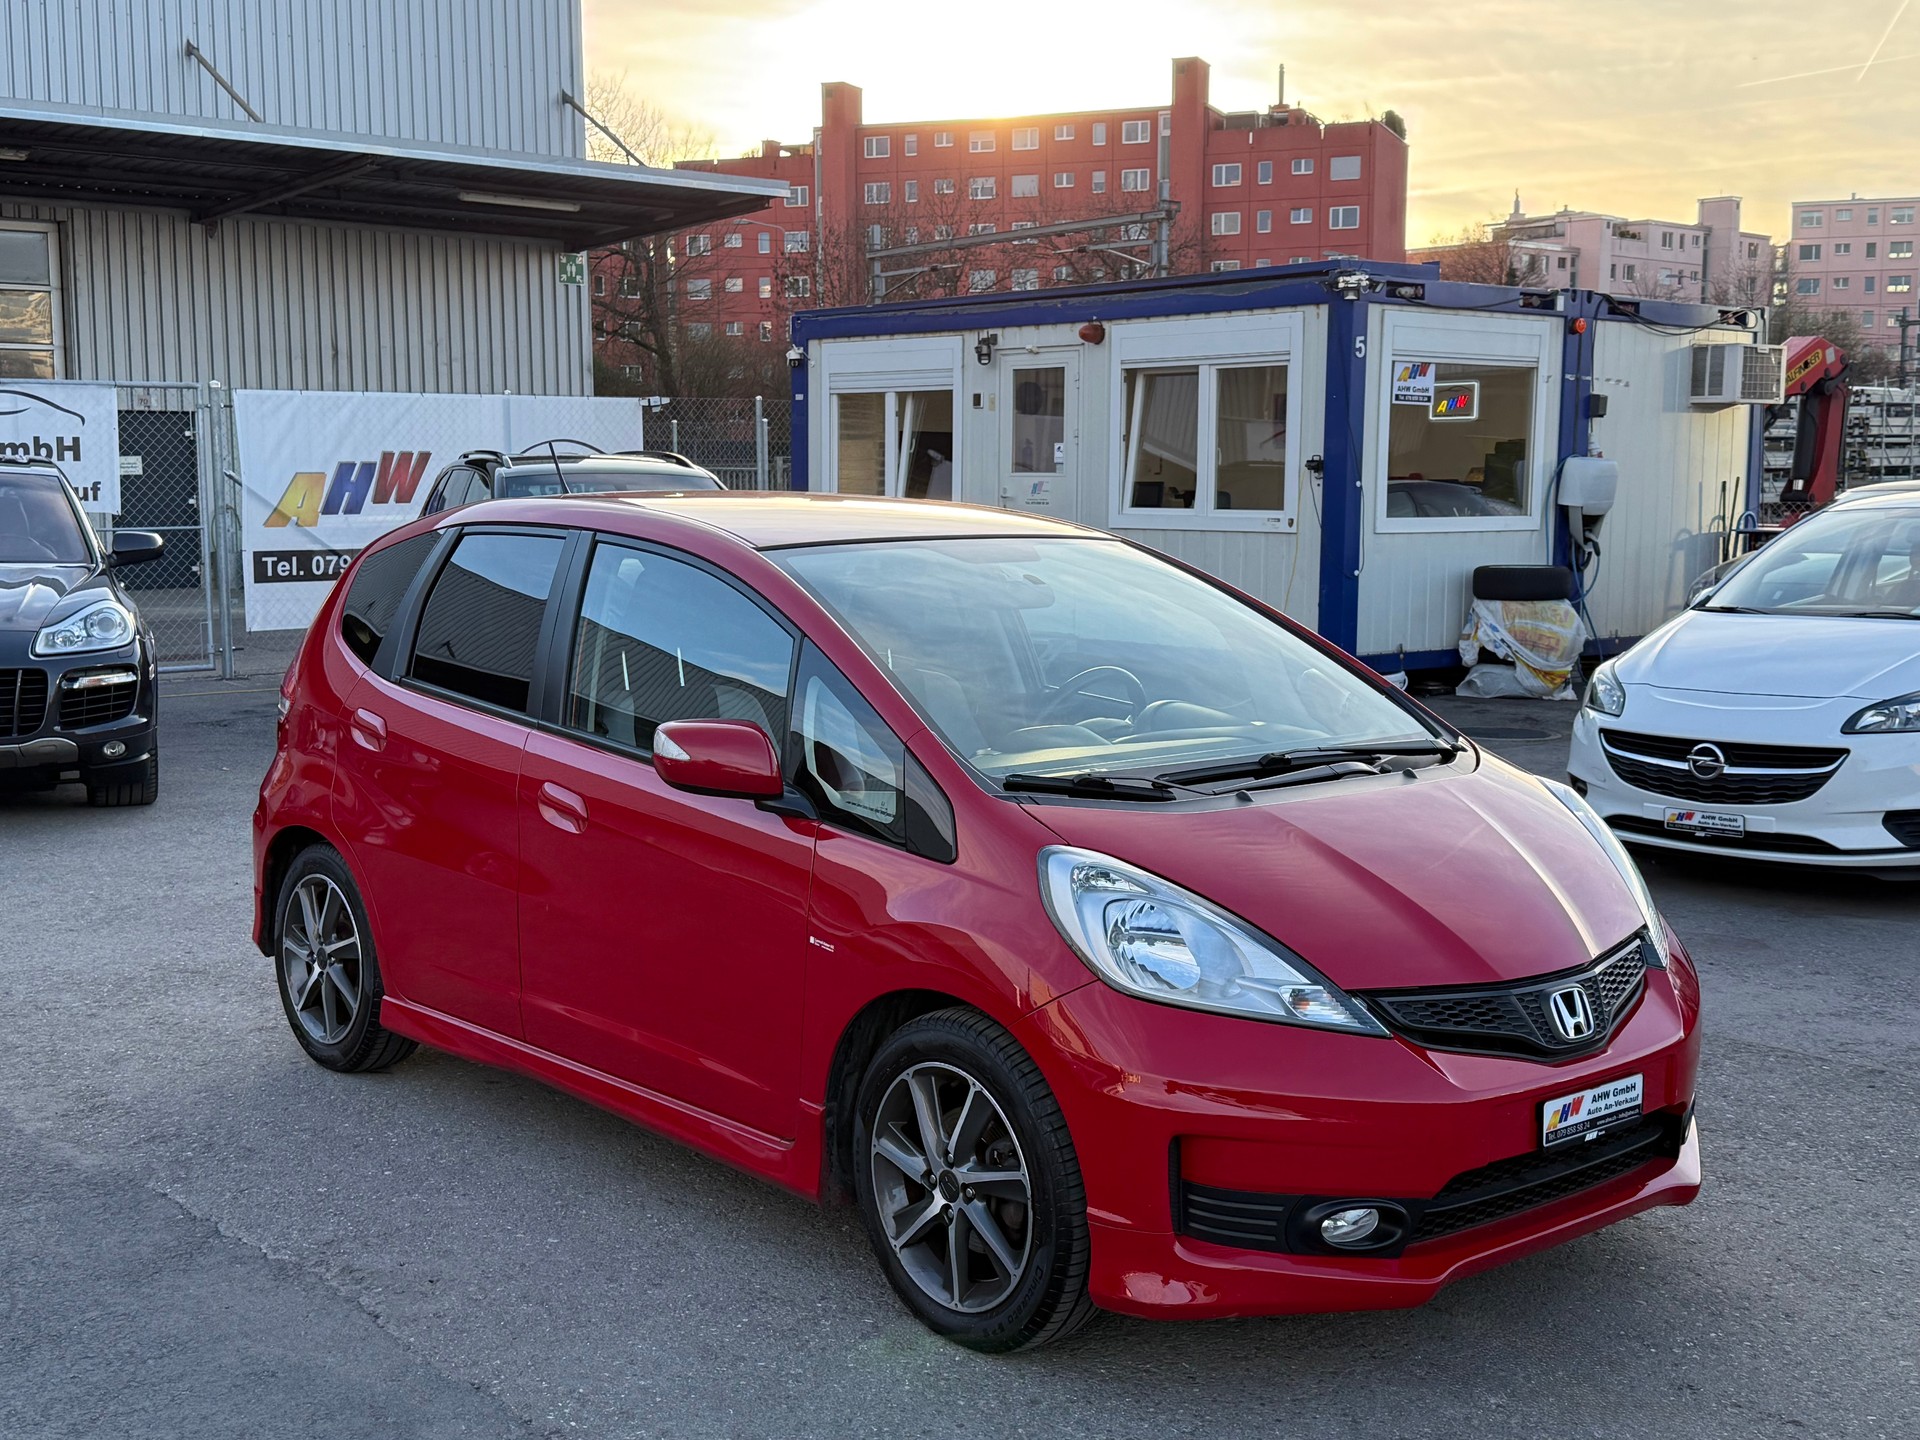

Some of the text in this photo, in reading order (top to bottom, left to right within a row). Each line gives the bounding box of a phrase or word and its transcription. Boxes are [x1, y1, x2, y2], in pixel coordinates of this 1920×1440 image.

[1355, 336, 1365, 358] 5
[1397, 362, 1431, 382] AHW
[1397, 385, 1411, 393] AHW
[1437, 395, 1469, 413] AHW
[0, 436, 81, 462] mbH
[263, 451, 432, 528] AHW
[262, 555, 352, 577] Tel. 079
[1591, 1082, 1636, 1104] AHW GmbH
[1546, 1095, 1584, 1132] AHW
[1587, 1106, 1602, 1116] Auto
[1604, 1094, 1639, 1111] An-Verkauf
